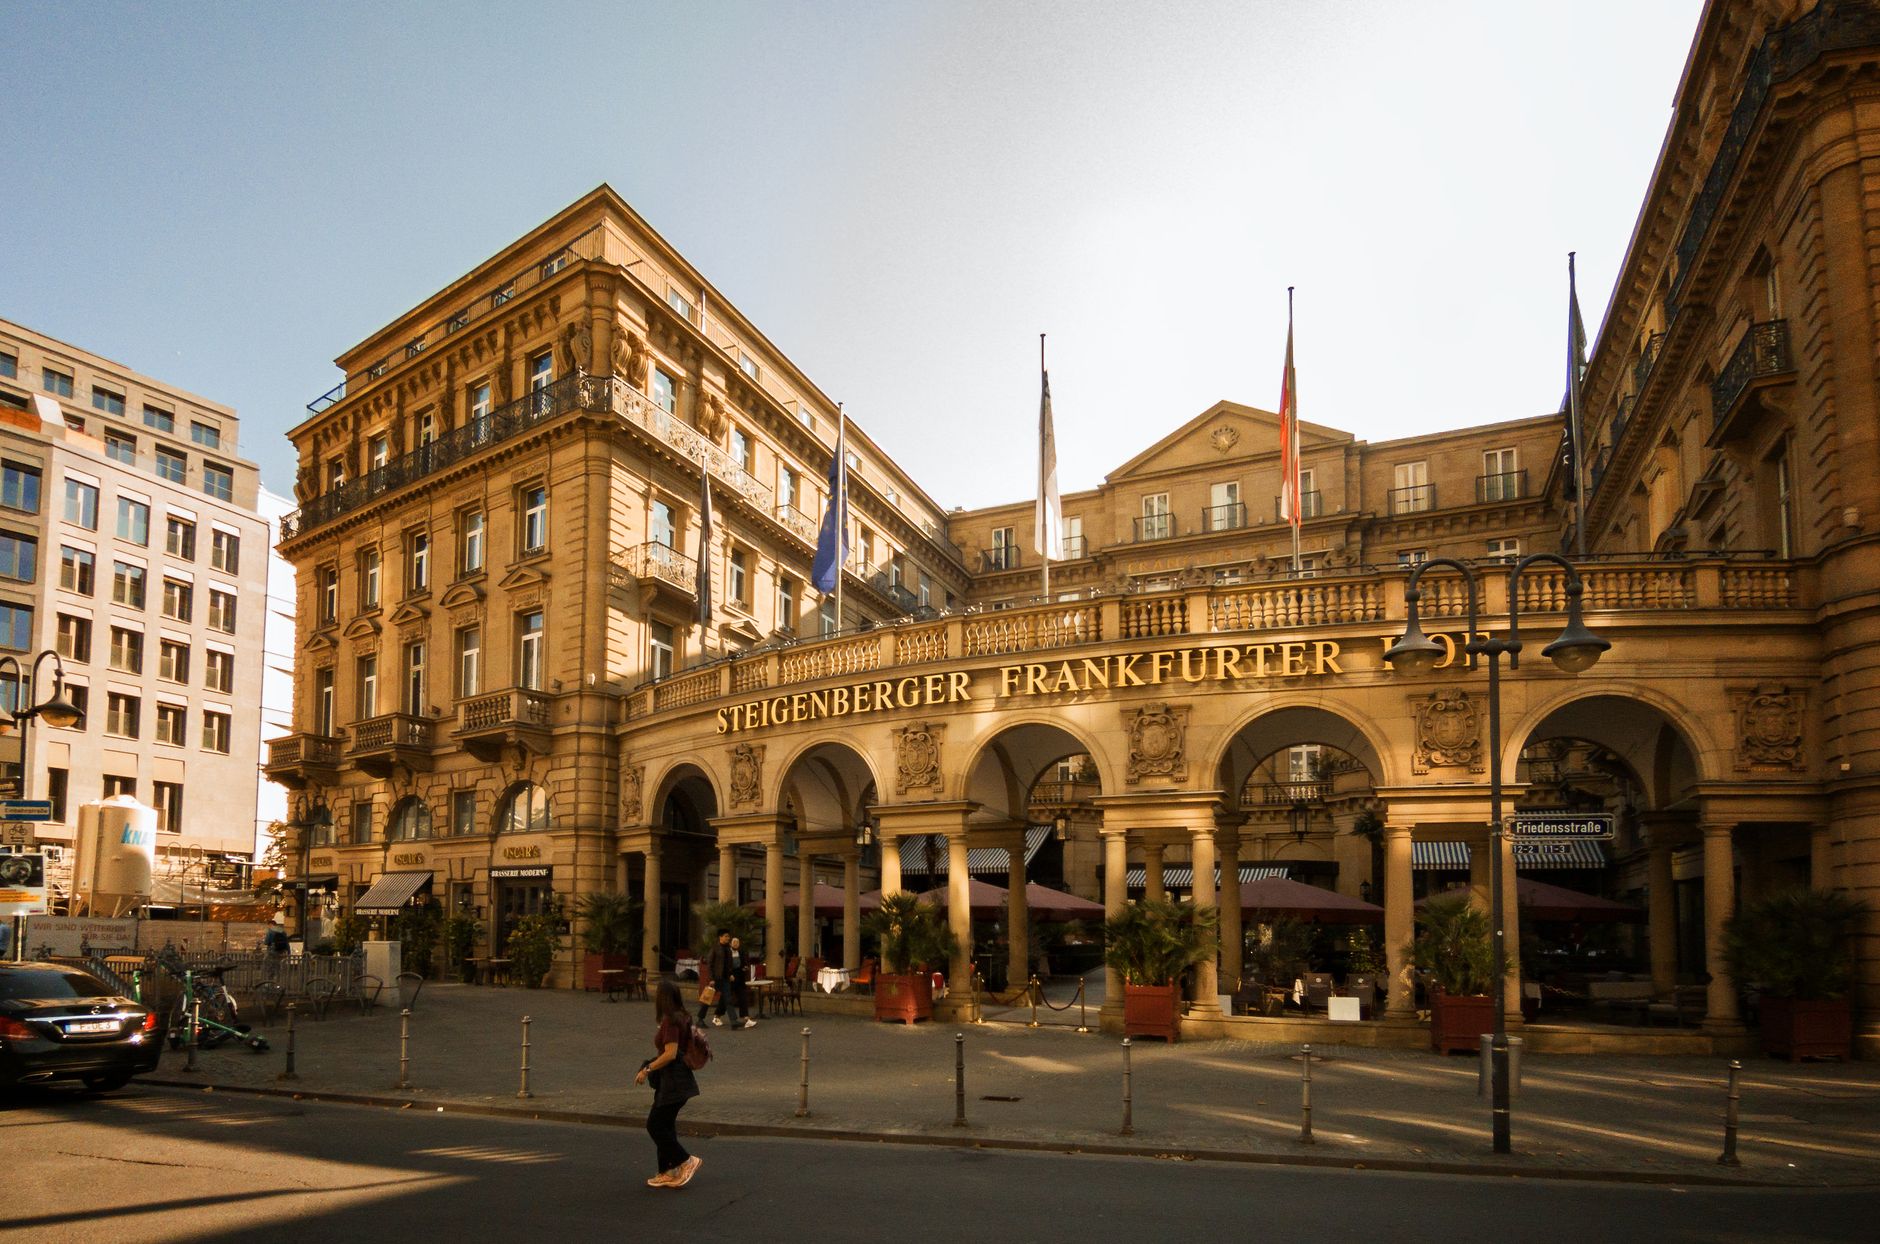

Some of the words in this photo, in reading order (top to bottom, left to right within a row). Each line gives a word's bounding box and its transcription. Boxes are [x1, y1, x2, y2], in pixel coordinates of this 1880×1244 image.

[716, 671, 972, 735] STEIGENBERGER
[999, 640, 1345, 698] FRANKFURTER
[1516, 821, 1601, 834] Friedensstraße
[1513, 845, 1534, 854] 12-2
[1543, 845, 1565, 854] 11-3
[33, 923, 51, 931] WIR
[55, 923, 77, 932] SIND
